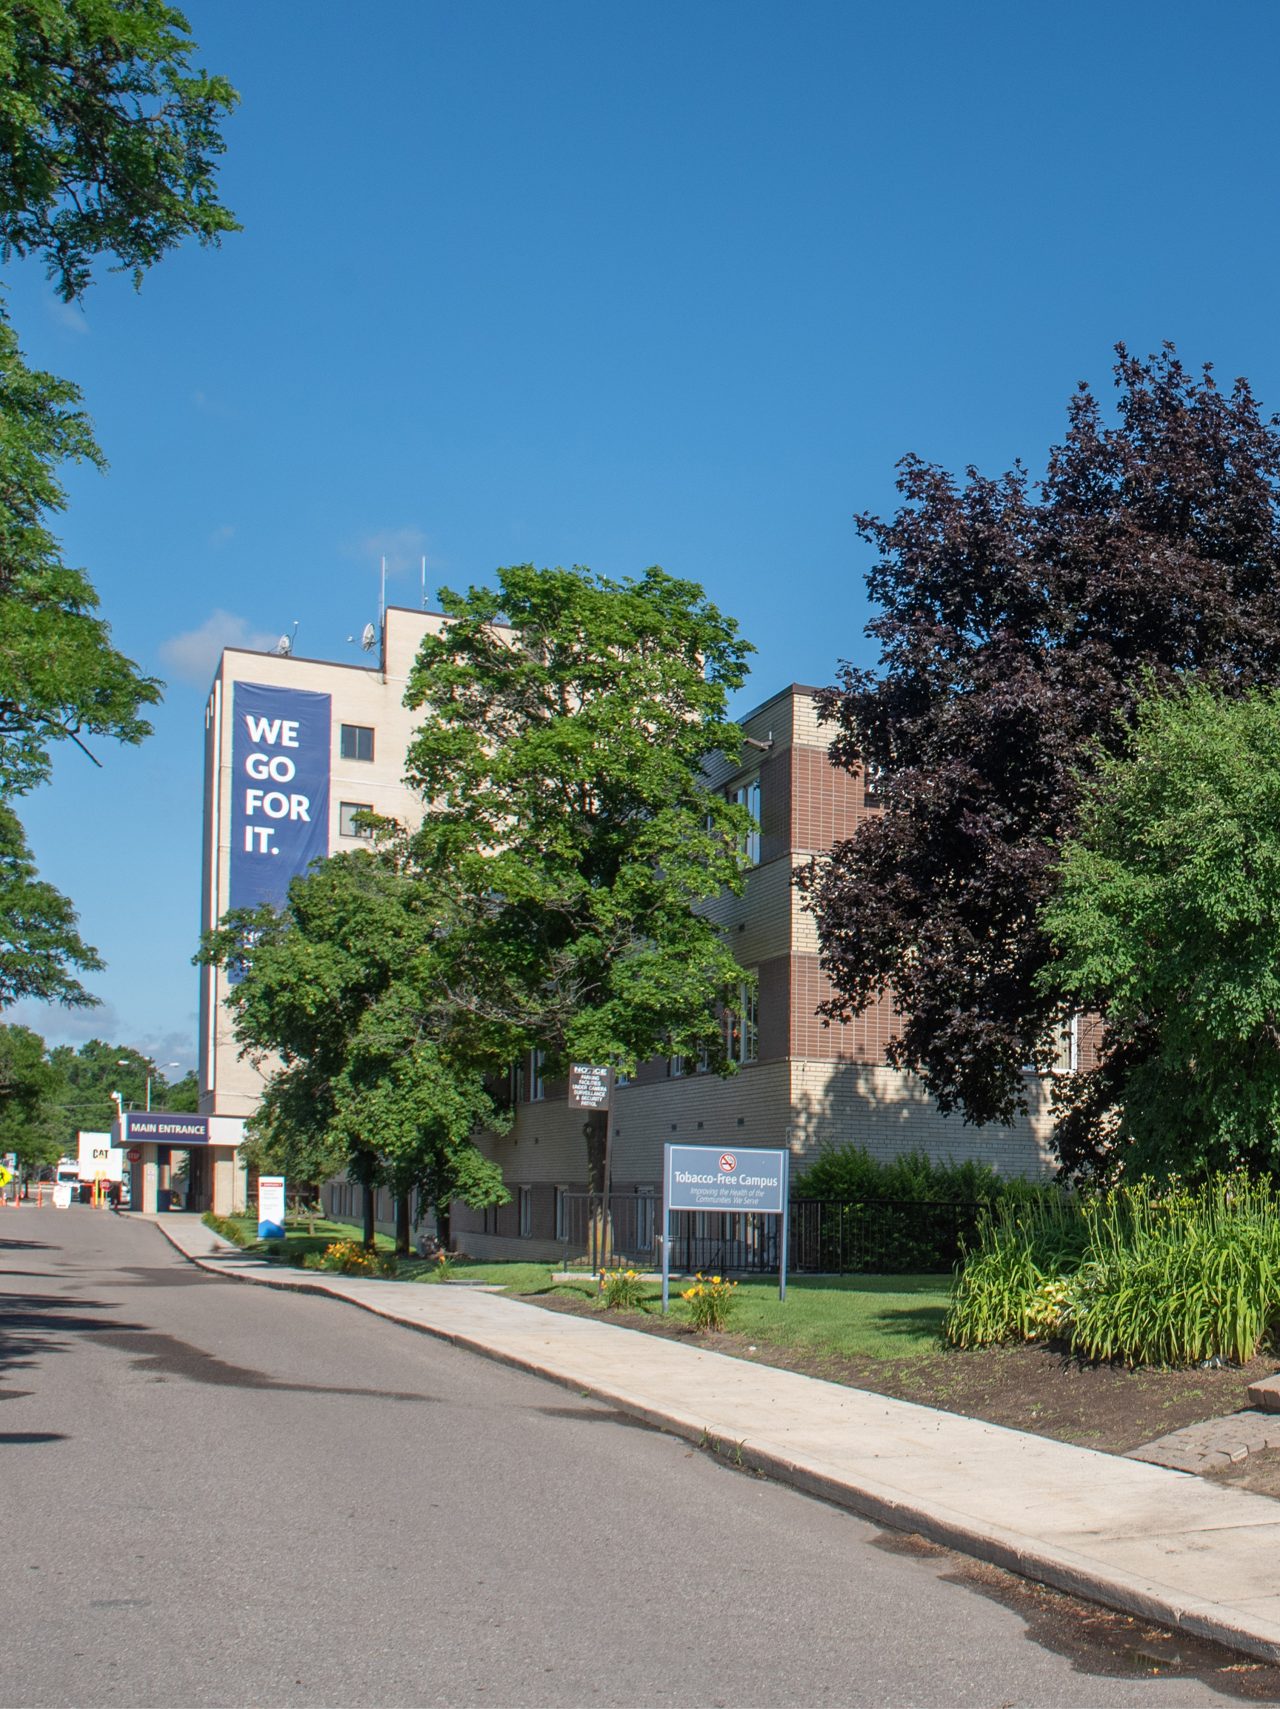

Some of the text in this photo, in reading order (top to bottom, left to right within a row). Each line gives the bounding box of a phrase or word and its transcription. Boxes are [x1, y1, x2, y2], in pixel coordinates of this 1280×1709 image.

[245, 715, 300, 748] WE
[245, 752, 296, 782] GO
[245, 788, 311, 822] FOR
[245, 825, 279, 854] IT.
[574, 1066, 607, 1076] NOTICE
[131, 1123, 206, 1134] MAIN ENTRANCE
[92, 1149, 109, 1159] CAT
[674, 1171, 777, 1188] Tobacco-Free Campus
[690, 1188, 718, 1197] Improving
[729, 1188, 747, 1196] Health
[748, 1188, 755, 1197] of
[756, 1189, 765, 1197] the
